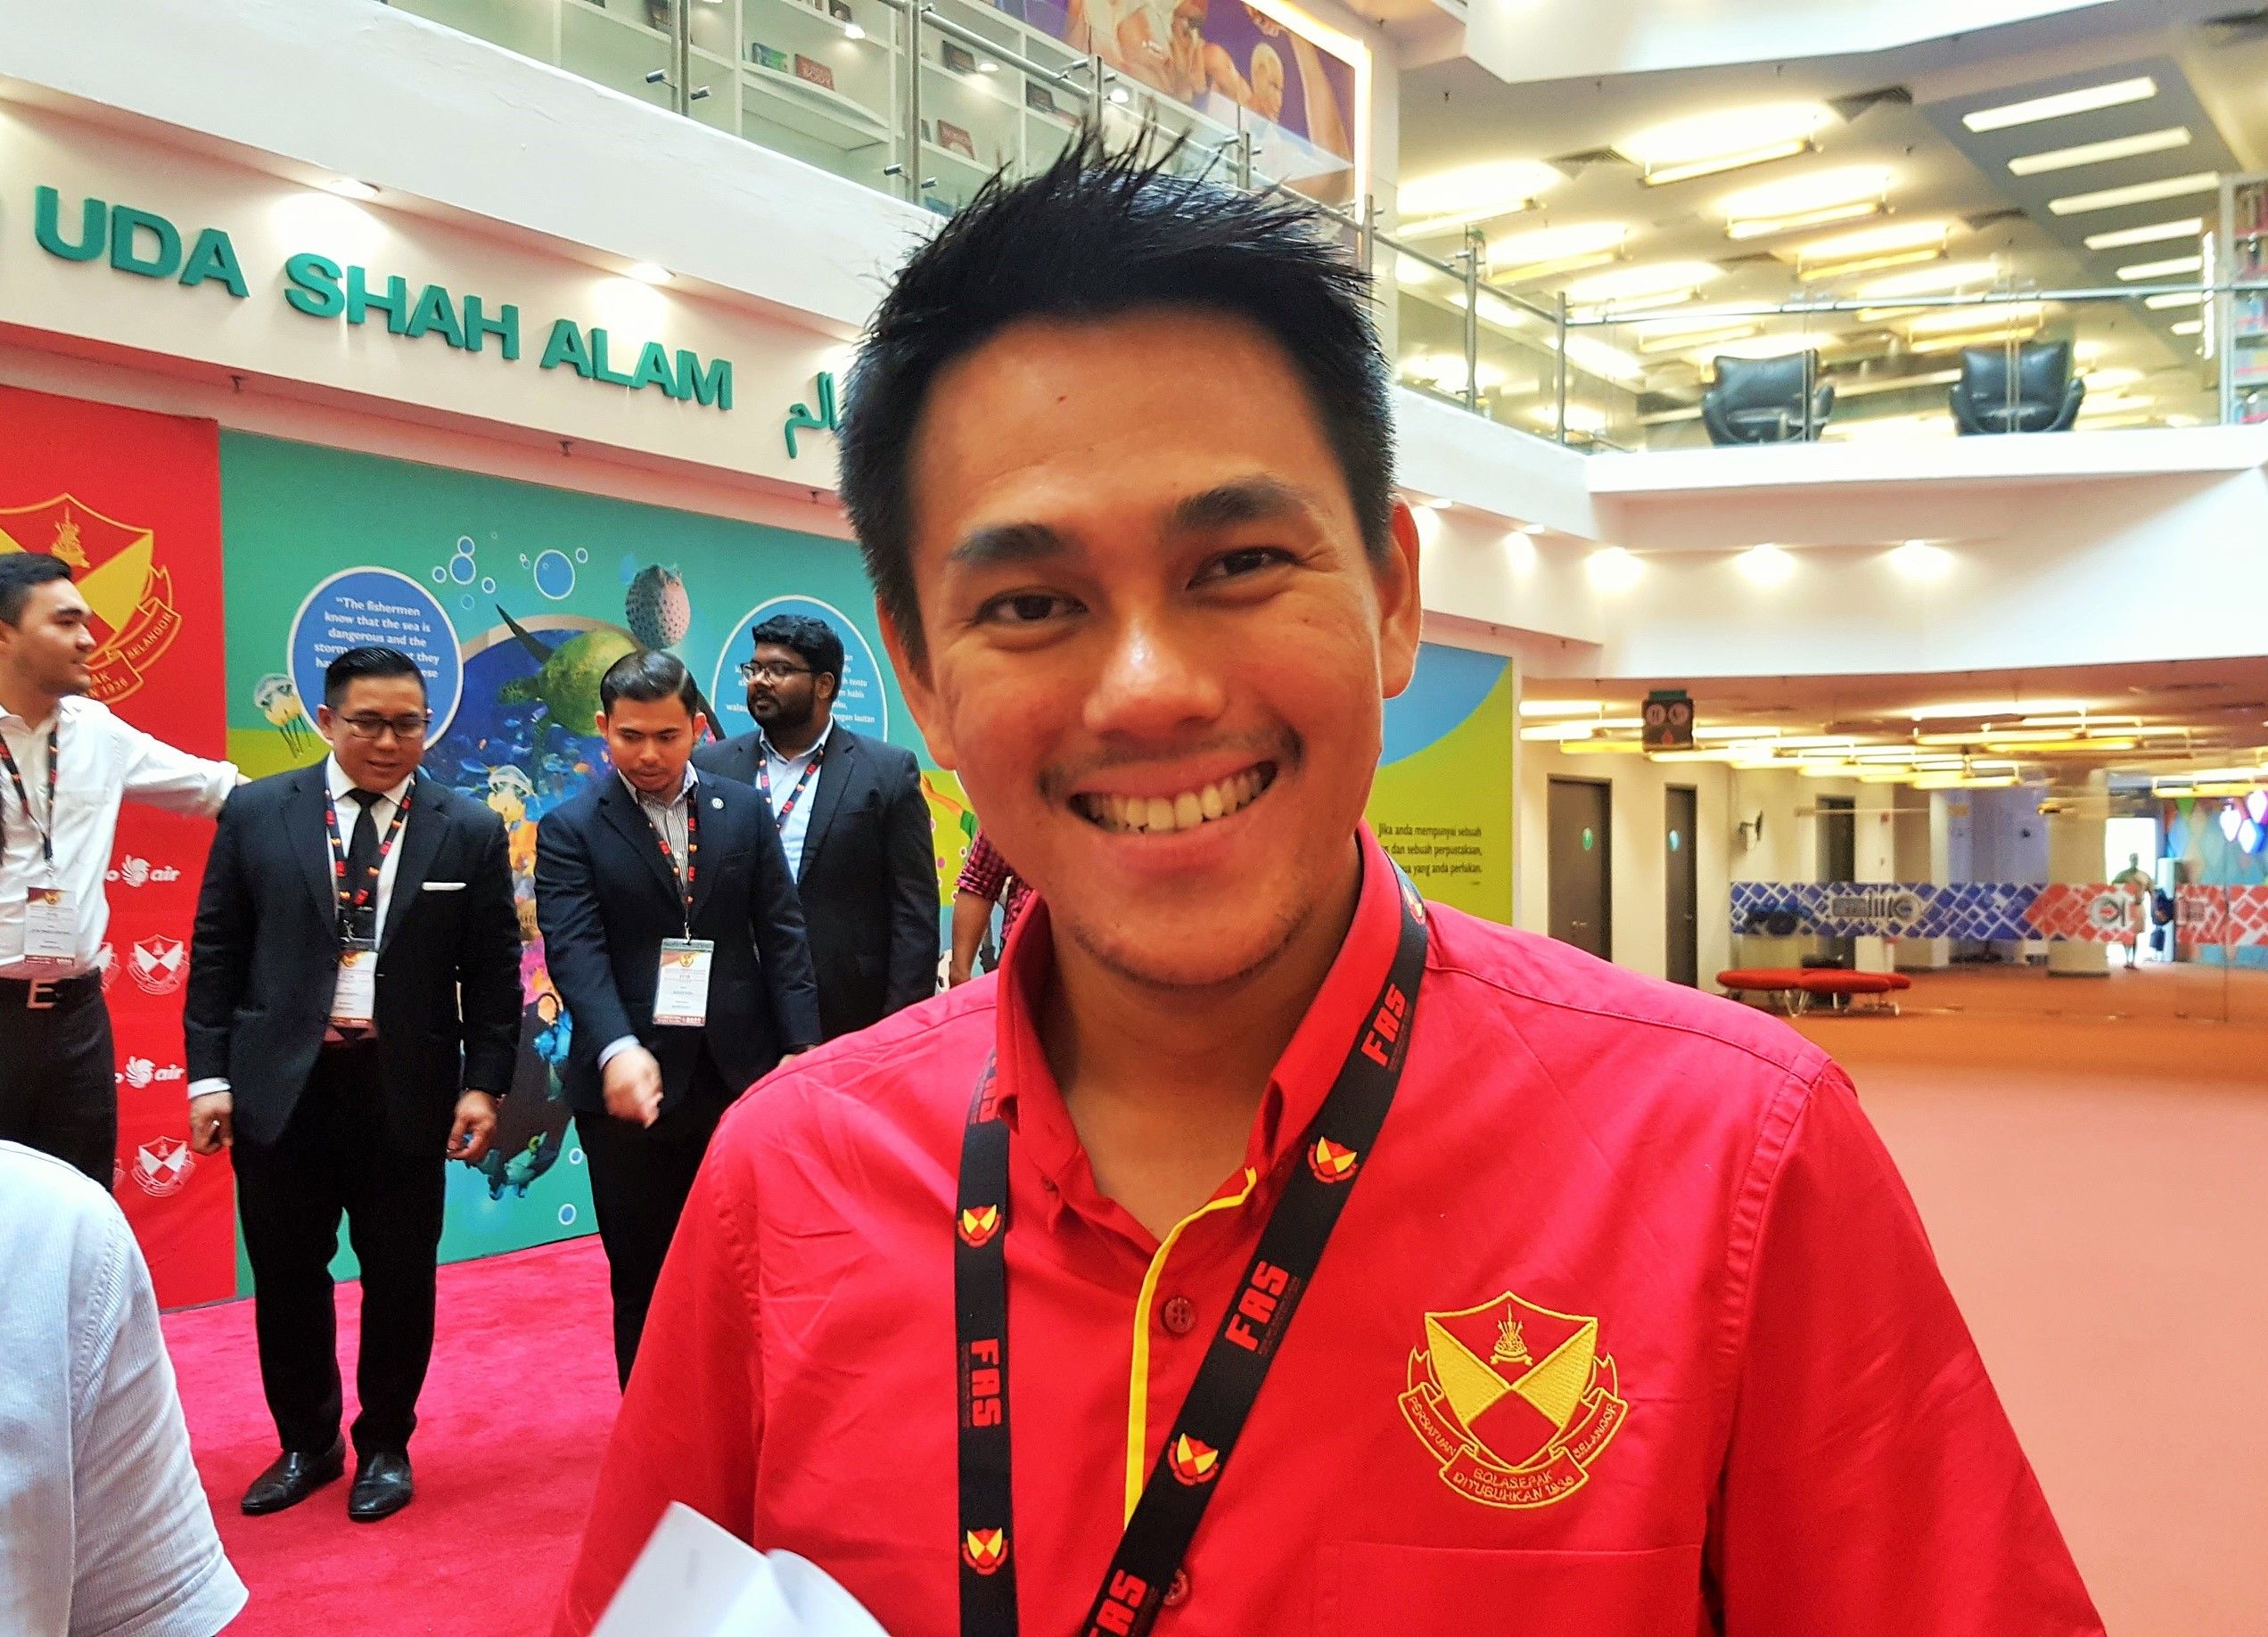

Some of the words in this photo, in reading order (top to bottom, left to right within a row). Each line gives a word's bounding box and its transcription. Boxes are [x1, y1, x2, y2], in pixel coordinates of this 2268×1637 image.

[35, 185, 251, 299] UDA
[285, 252, 521, 360] SHAH
[540, 318, 733, 411] ALAM
[366, 600, 421, 616] fishermen
[325, 611, 355, 623] know
[357, 615, 380, 627] that
[382, 618, 400, 629] the
[402, 621, 420, 632] sea
[422, 621, 431, 632] is
[328, 628, 385, 642] dangerous
[386, 634, 407, 646] and
[409, 637, 427, 646] the
[416, 651, 440, 665] they
[1395, 824, 1413, 835] anda
[1458, 826, 1482, 836] sebuah
[1407, 843, 1433, 854] sebuah
[150, 865, 181, 883] air
[1361, 983, 1407, 1067] FAS
[1225, 1260, 1289, 1352] FAS
[971, 1338, 1002, 1427] FAS
[1452, 1472, 1543, 1502] DITUBUHKAN
[1473, 1468, 1553, 1489] BOLASEPAK
